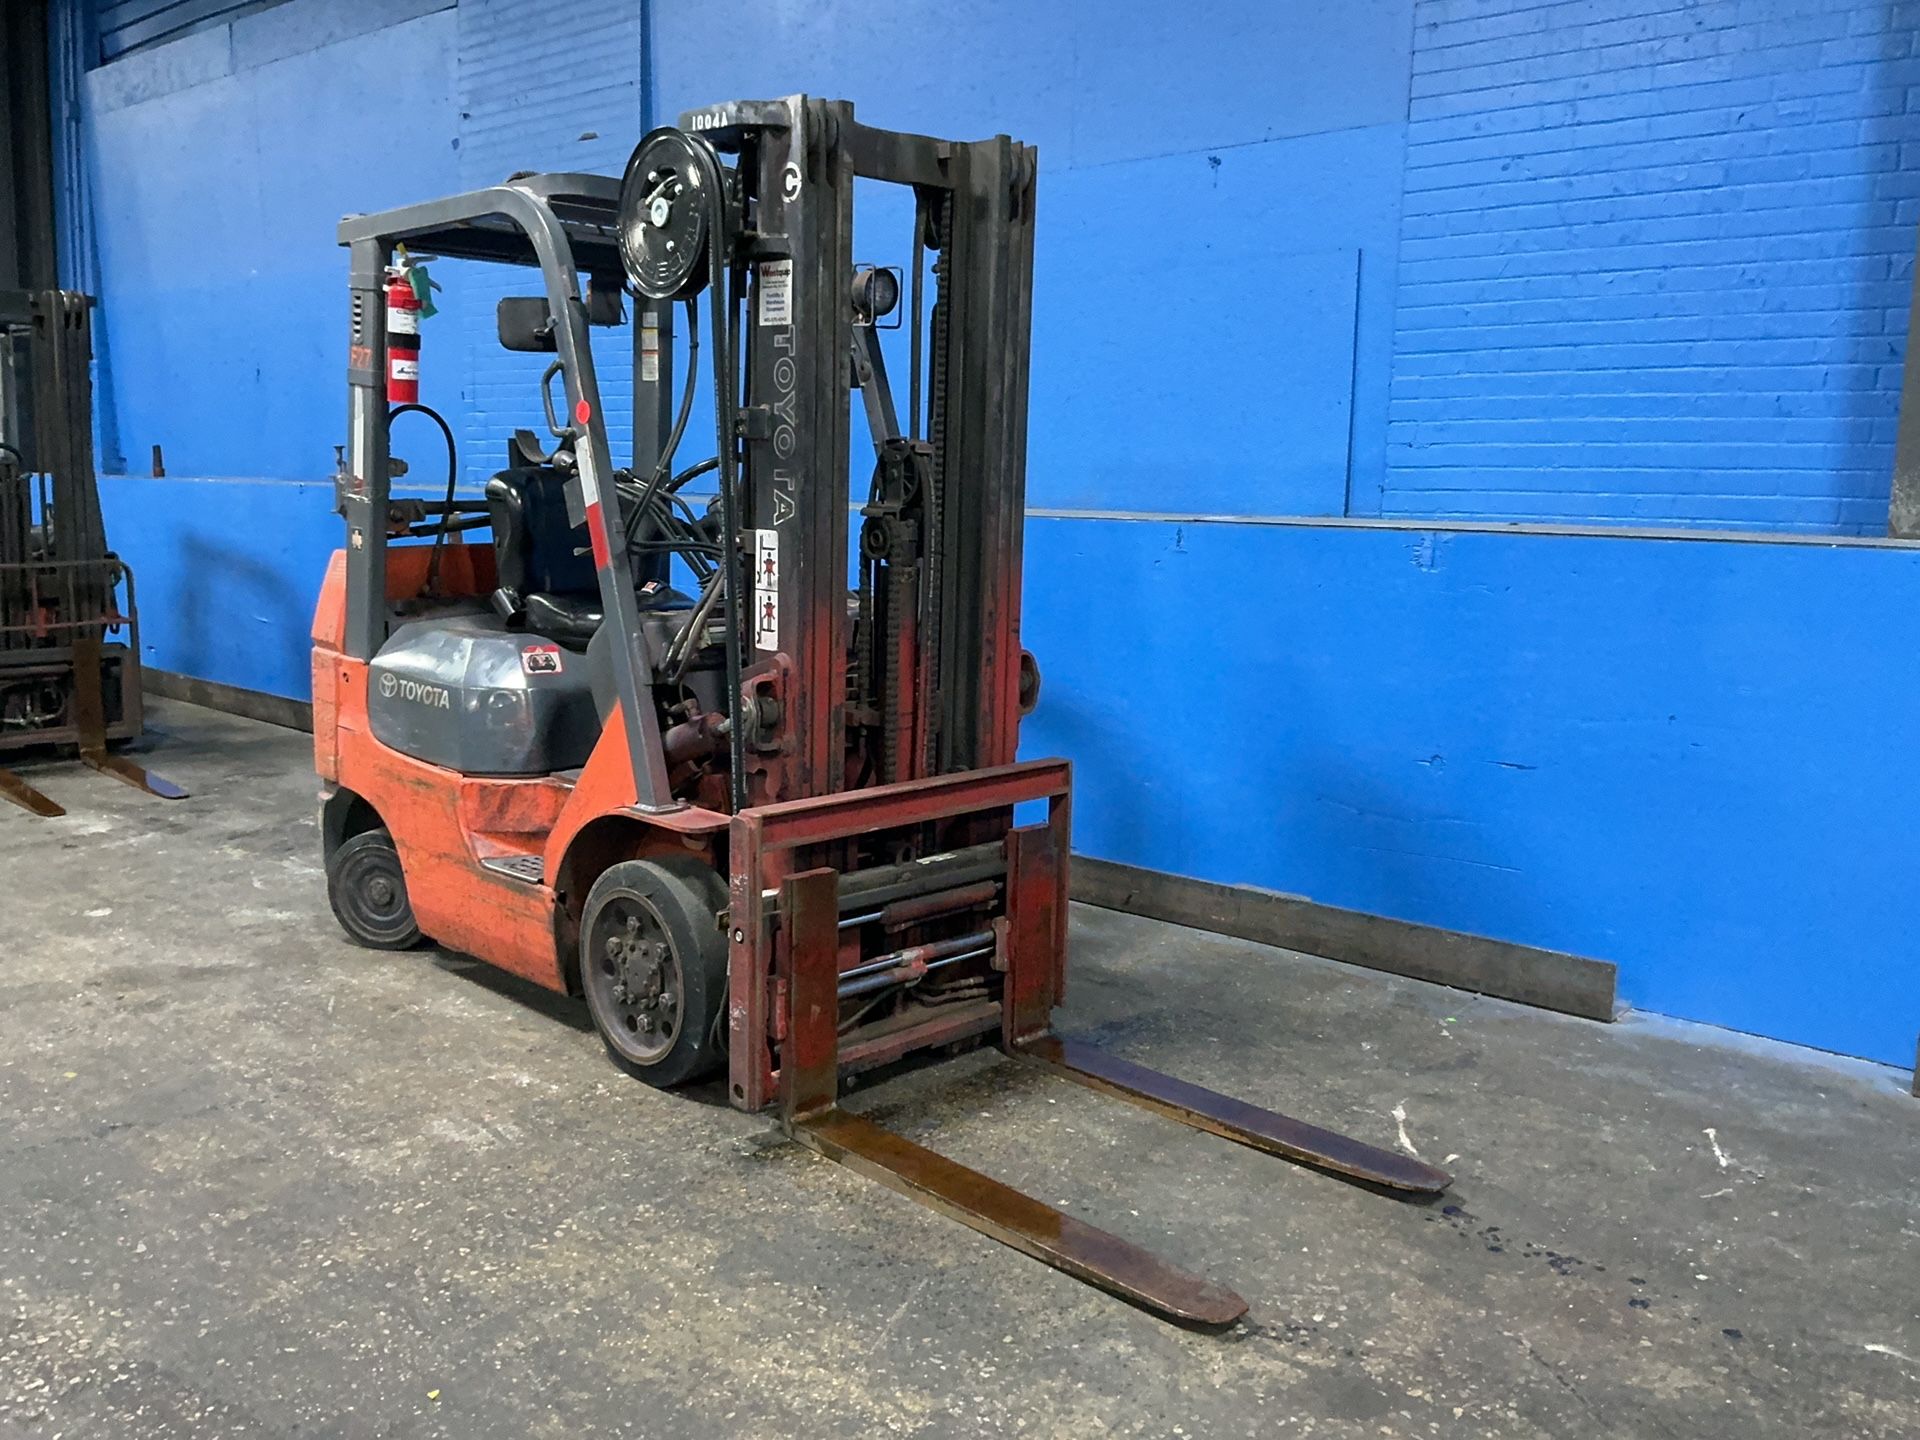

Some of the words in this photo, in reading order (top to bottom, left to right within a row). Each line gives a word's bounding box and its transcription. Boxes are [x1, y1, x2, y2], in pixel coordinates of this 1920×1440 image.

[692, 111, 728, 131] 1004A
[773, 324, 796, 526] TOYOTA
[400, 679, 449, 709] TOYOTA
